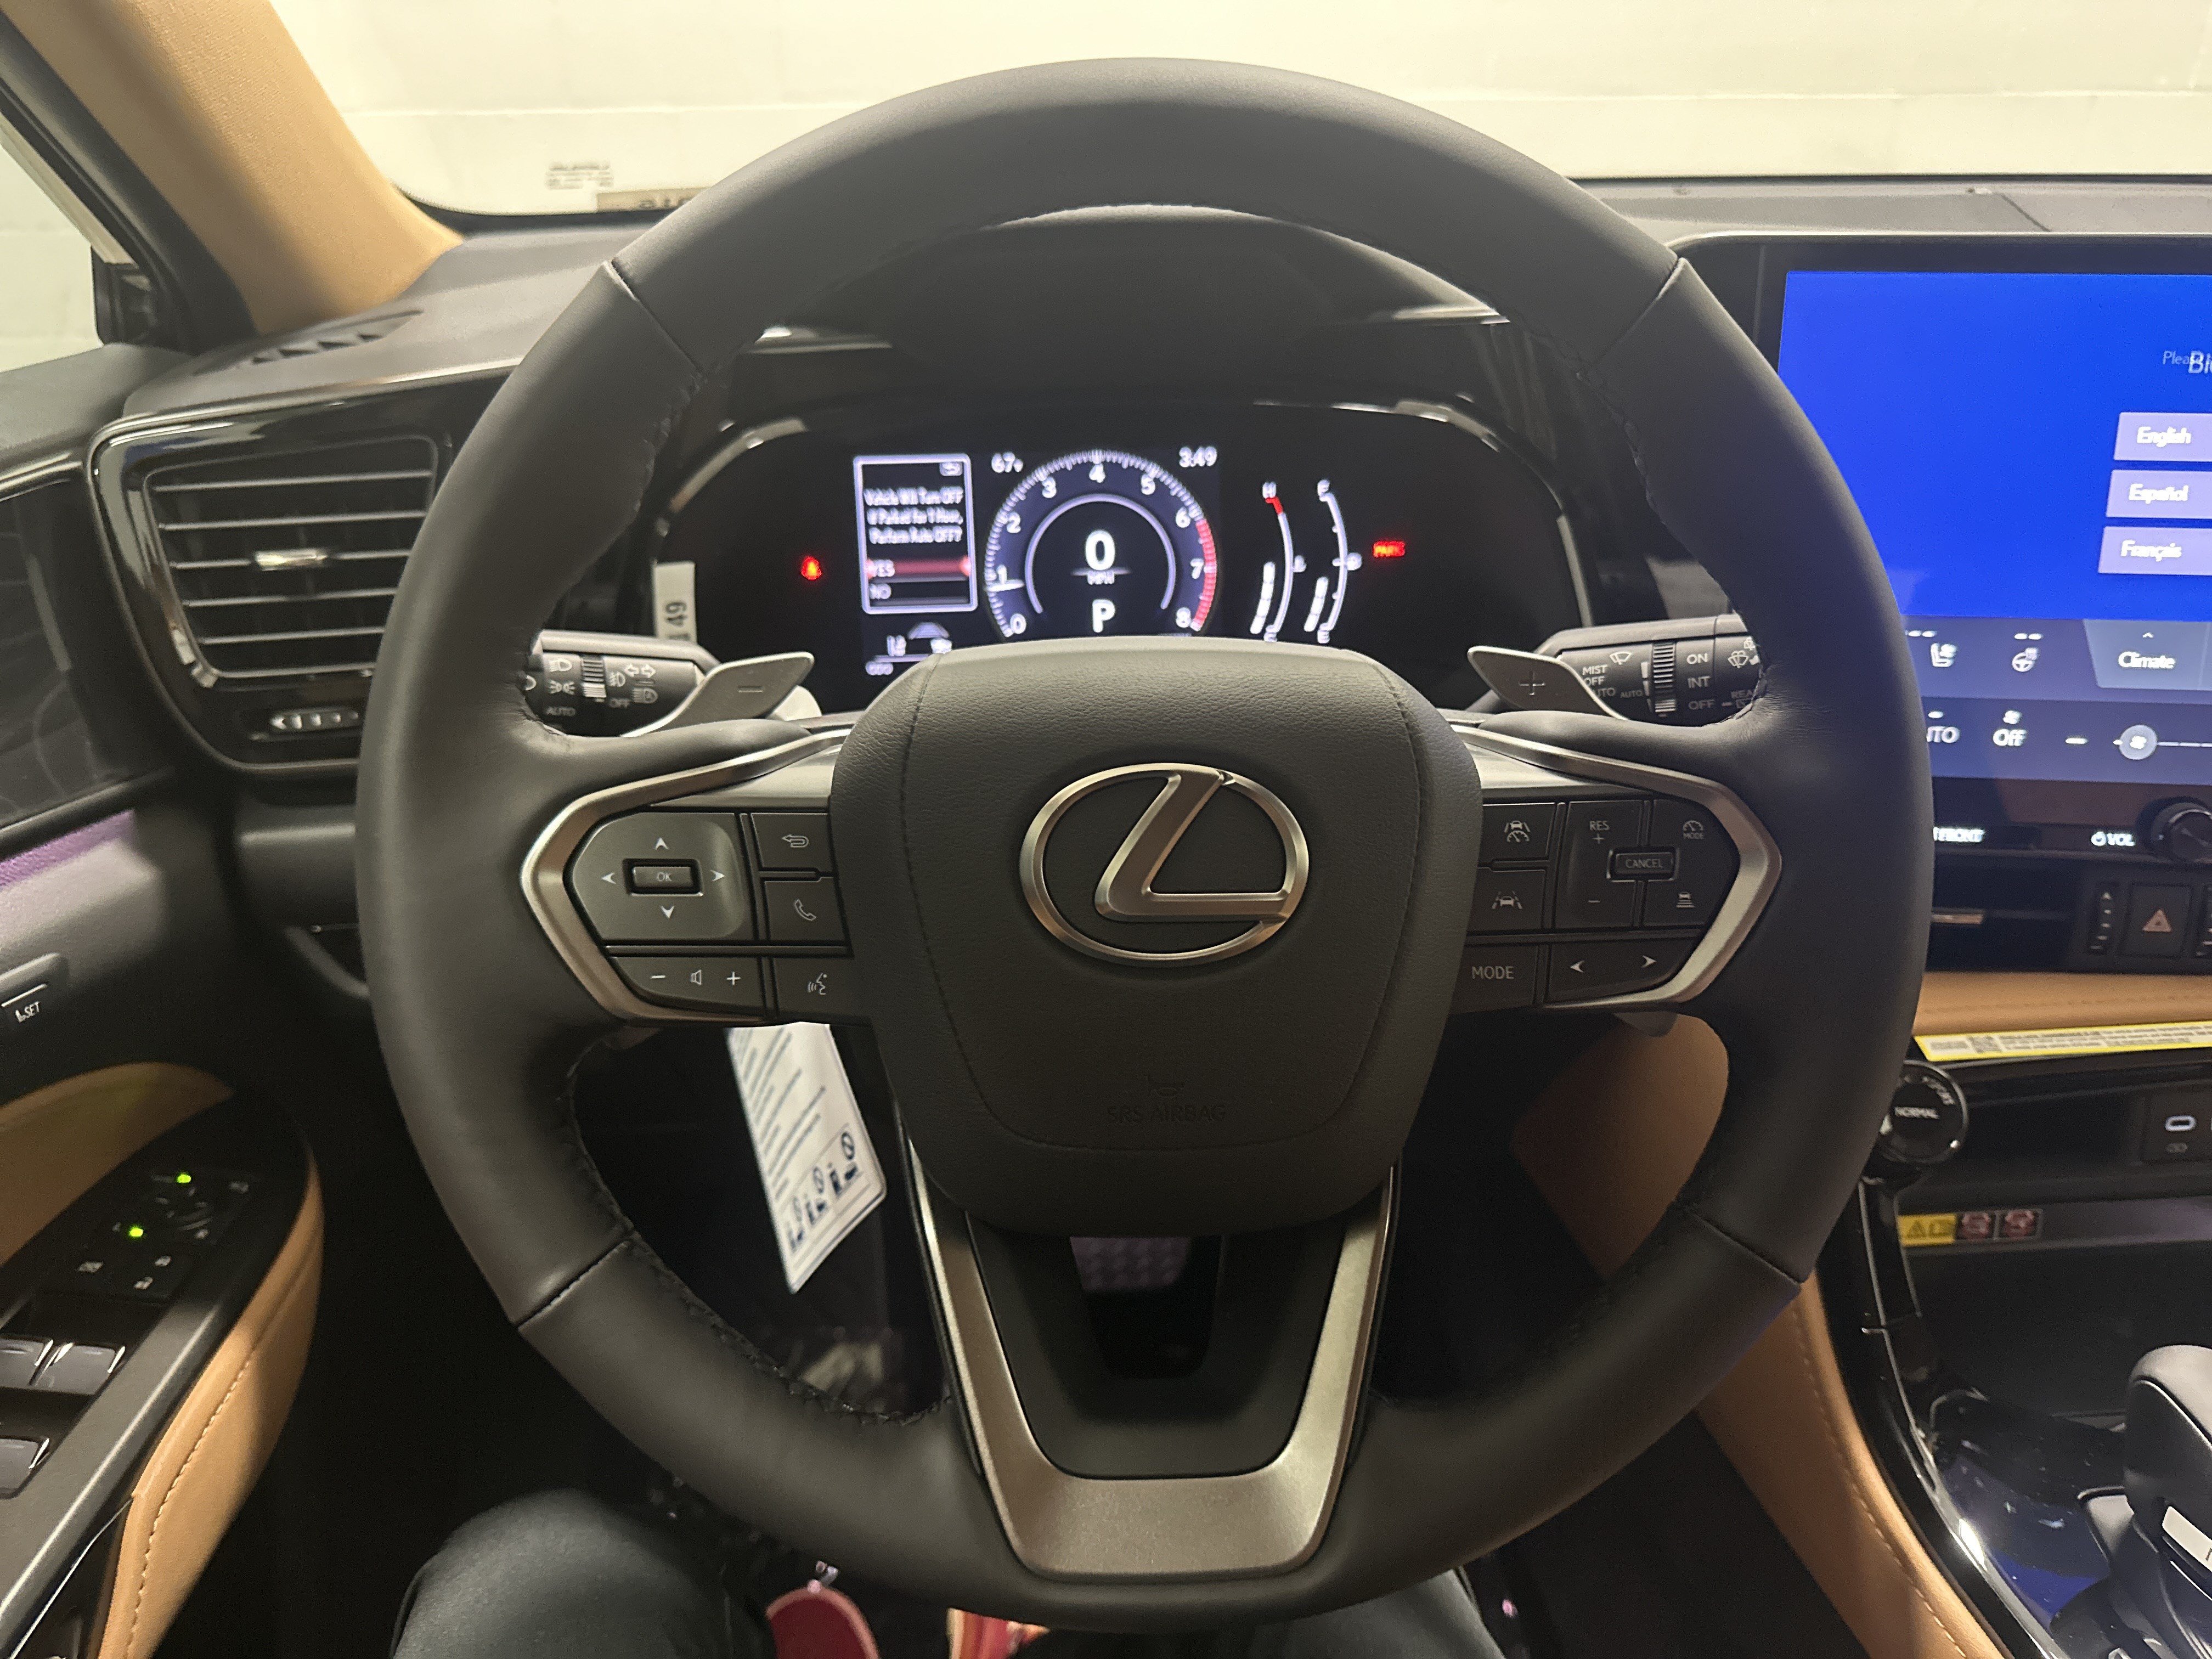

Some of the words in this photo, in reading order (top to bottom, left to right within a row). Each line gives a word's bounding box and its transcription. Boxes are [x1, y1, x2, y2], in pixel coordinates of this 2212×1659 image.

[2136, 426, 2192, 448] English
[1179, 446, 1217, 467] 3:49
[1089, 460, 1106, 483] 4
[1042, 476, 1057, 499] 3
[1141, 473, 1156, 495] 5
[2128, 483, 2189, 504] Español
[1006, 511, 1022, 533] 2
[1176, 506, 1191, 528] 6
[1085, 529, 1116, 571] 0
[1190, 557, 1205, 579] 7
[1010, 613, 1026, 634] 0
[1092, 599, 1116, 633] P
[1176, 607, 1191, 628] 8
[1686, 652, 1709, 664] ON
[2118, 651, 2176, 669] Climate
[1582, 664, 1608, 676] MIST
[1584, 675, 1605, 686] OFF
[1688, 675, 1711, 689] INT
[1620, 690, 1644, 698] AUTO
[1731, 690, 1754, 699] REA
[546, 706, 576, 716] AUTO
[1688, 699, 1715, 710] OFF
[1993, 729, 2028, 746] Off
[1589, 820, 1610, 831] RES
[1939, 827, 1985, 843] FRONT
[2106, 833, 2135, 847] VOL
[1625, 858, 1663, 868] CANCEL
[657, 872, 673, 882] OK
[1471, 966, 1515, 979] MODE
[24, 1001, 40, 1019] SET
[1107, 1104, 1144, 1124] SRS
[1149, 1103, 1228, 1123] AIRBAG
[1894, 1107, 1940, 1120] NORMAL
